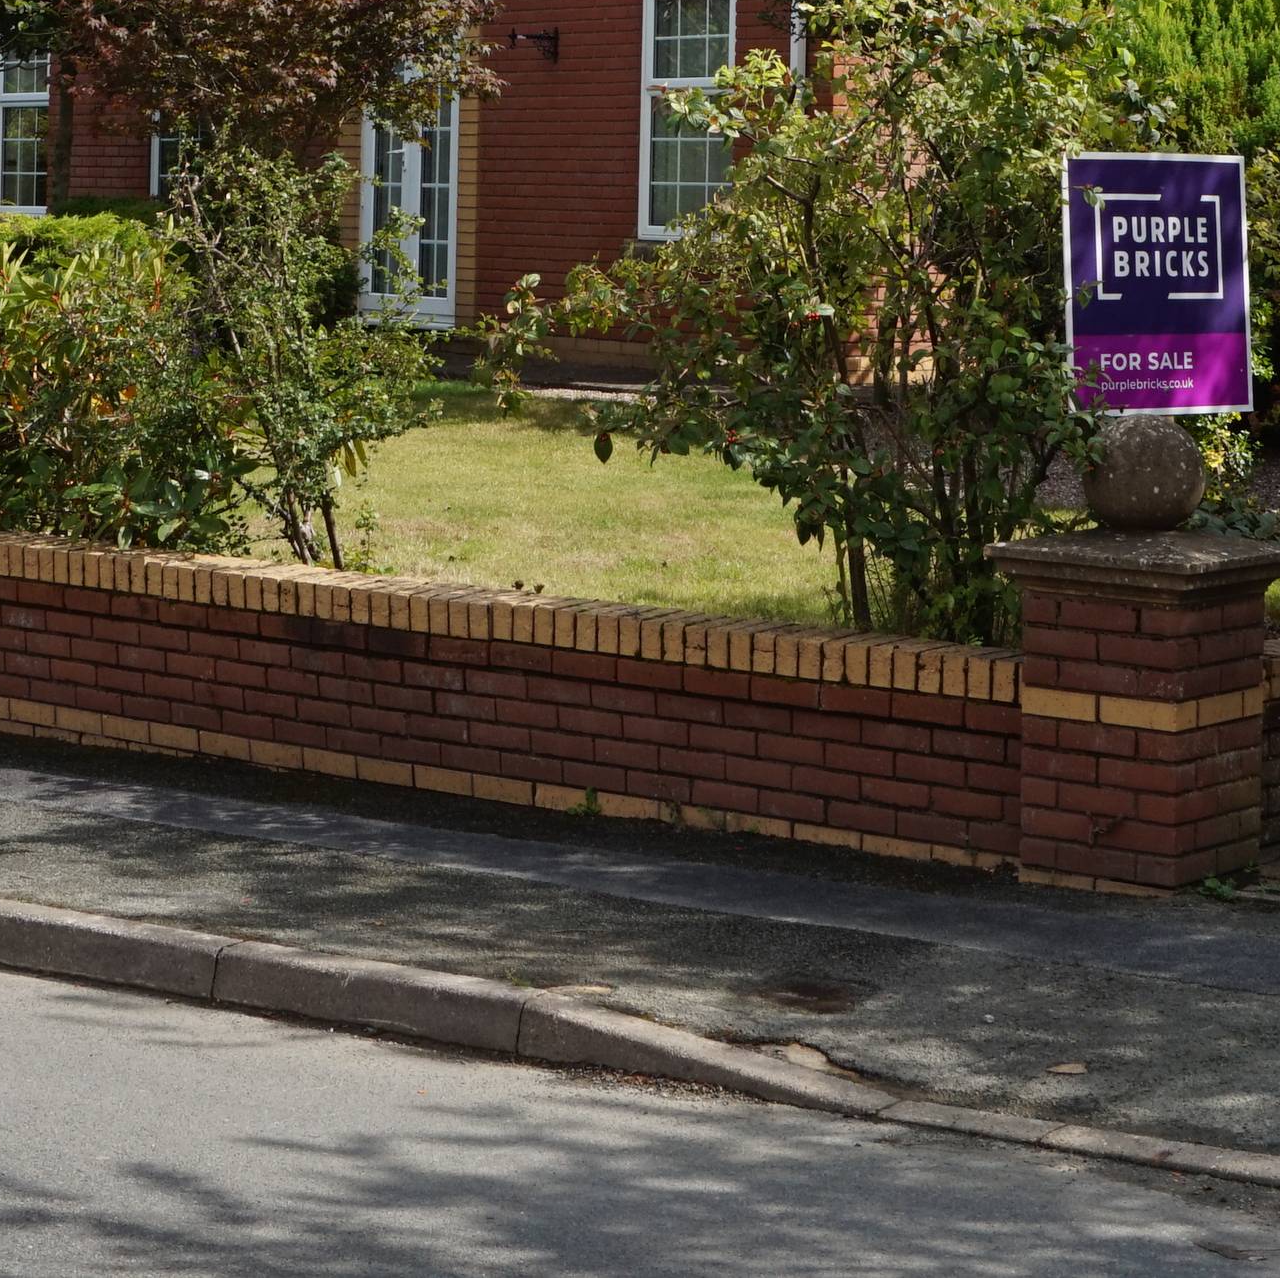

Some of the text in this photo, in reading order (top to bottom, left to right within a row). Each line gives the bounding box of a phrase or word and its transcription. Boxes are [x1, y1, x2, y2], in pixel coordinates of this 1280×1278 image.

[1112, 216, 1208, 243] PURPLE
[1114, 250, 1209, 278] BRICKS
[1100, 352, 1193, 371] FOR SALE
[1101, 378, 1194, 392] purplebricks.co.uk
